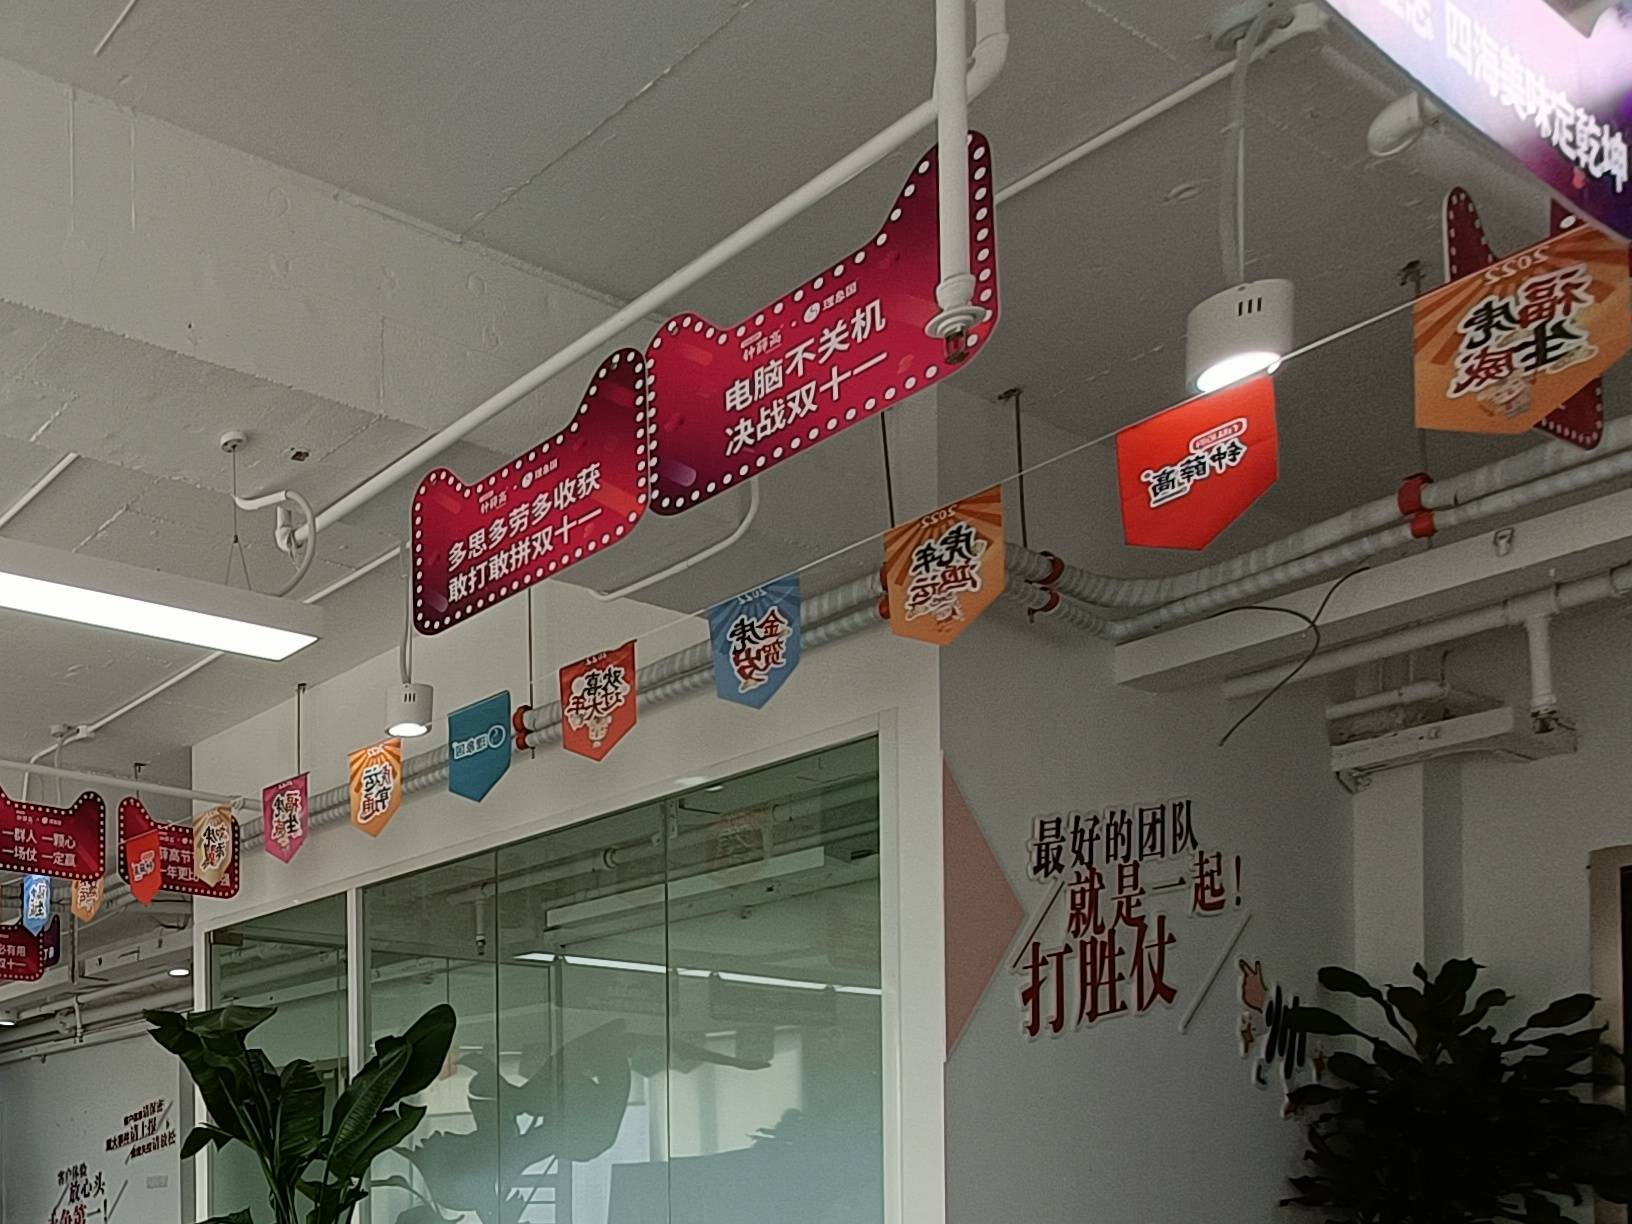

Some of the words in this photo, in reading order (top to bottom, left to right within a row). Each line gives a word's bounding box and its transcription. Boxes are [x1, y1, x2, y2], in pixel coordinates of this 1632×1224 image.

[725, 299, 887, 412] 电脑不关机
[725, 352, 888, 456] 决战双十一
[448, 463, 601, 572] 多思多劳多收获
[448, 508, 602, 603] 敢打敢拼双十一
[1, 845, 38, 862] 一场仗
[41, 851, 76, 868] 一定赢
[2, 827, 38, 844] 一群人
[41, 832, 76, 849] 一颗心
[1033, 799, 1199, 879] 最好的团队
[1021, 914, 1178, 1038] 打胜仗
